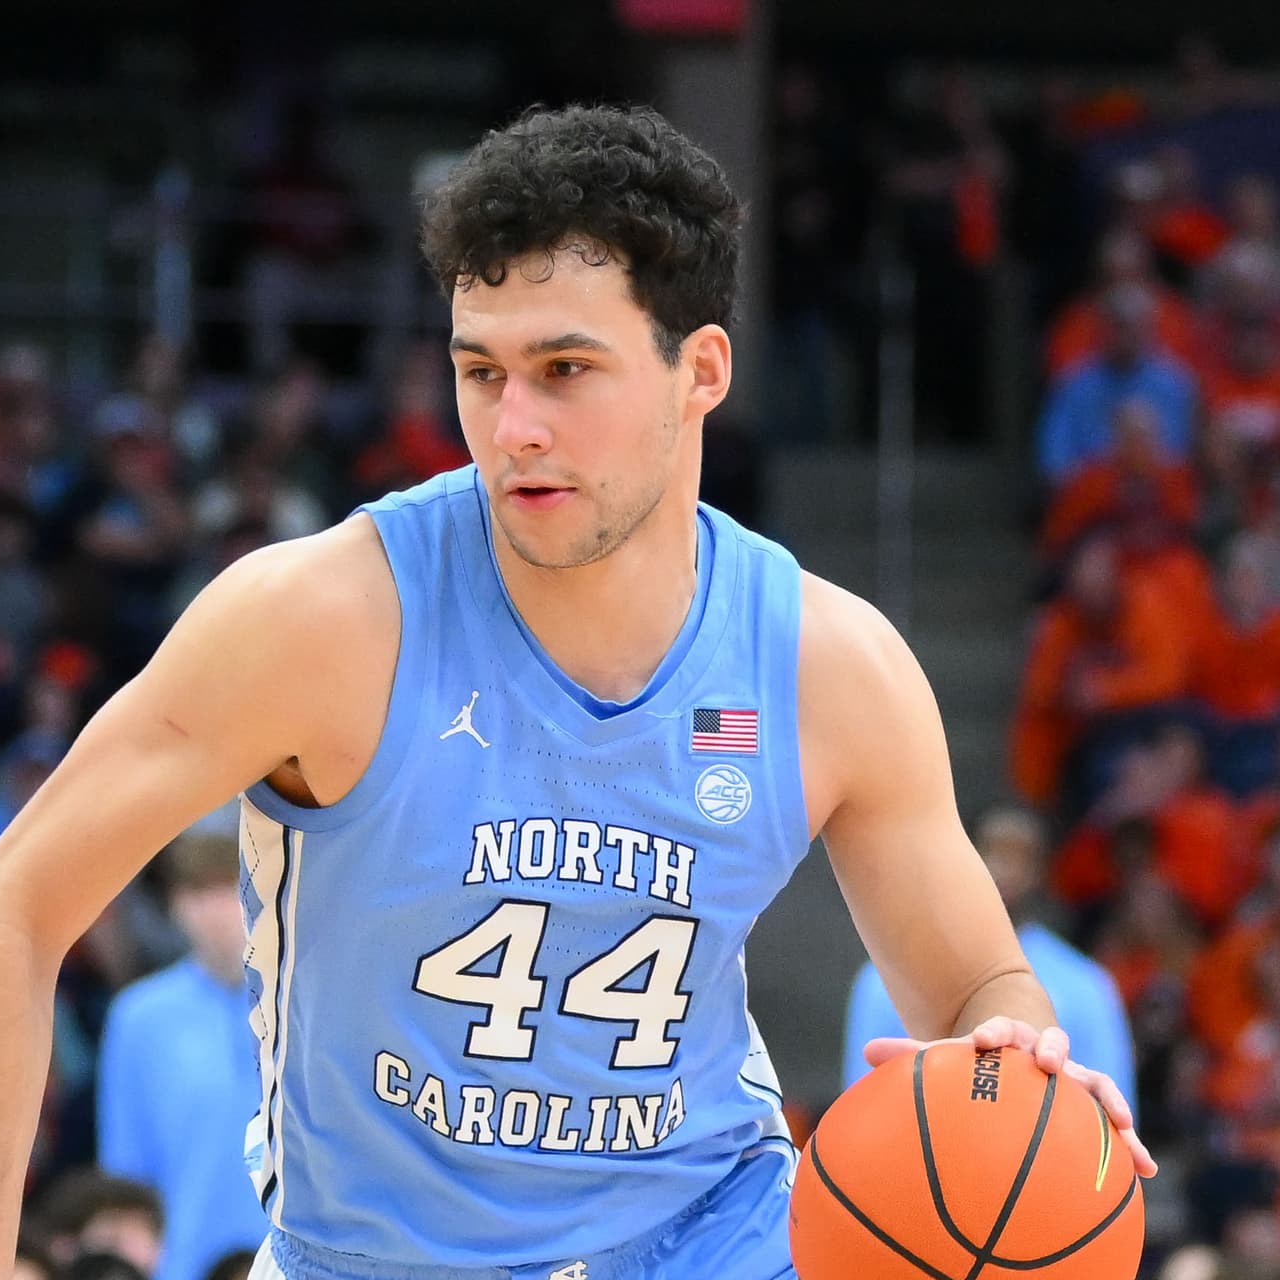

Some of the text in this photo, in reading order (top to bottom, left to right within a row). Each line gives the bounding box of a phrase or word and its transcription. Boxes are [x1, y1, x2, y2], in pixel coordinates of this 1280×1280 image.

[702, 784, 748, 800] ACC
[463, 817, 696, 909] NORTH
[411, 898, 700, 1071] 44
[374, 1050, 686, 1154] CAROLINA
